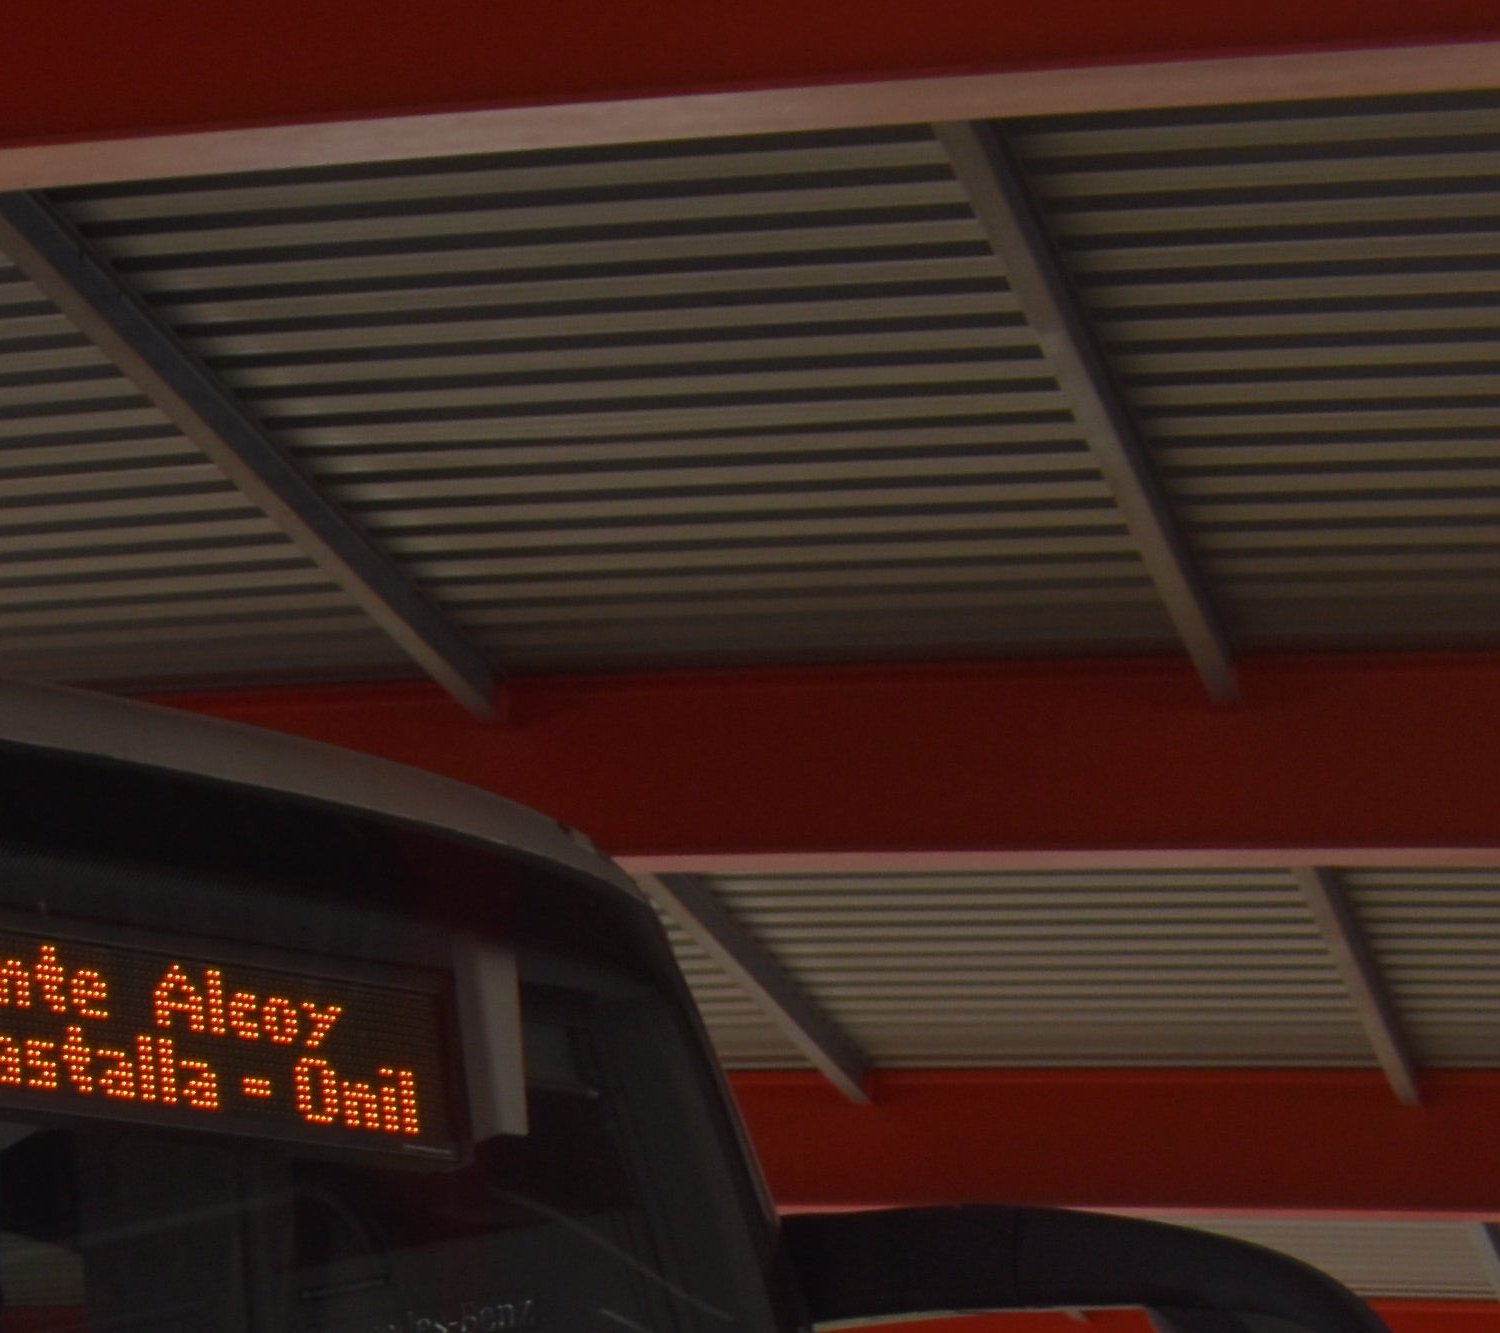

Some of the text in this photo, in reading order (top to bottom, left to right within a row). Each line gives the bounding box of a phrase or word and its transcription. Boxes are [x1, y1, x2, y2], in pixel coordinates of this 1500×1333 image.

[151, 962, 343, 1048] Alcoy
[242, 1077, 271, 1097] -
[296, 1056, 421, 1135] Onil
